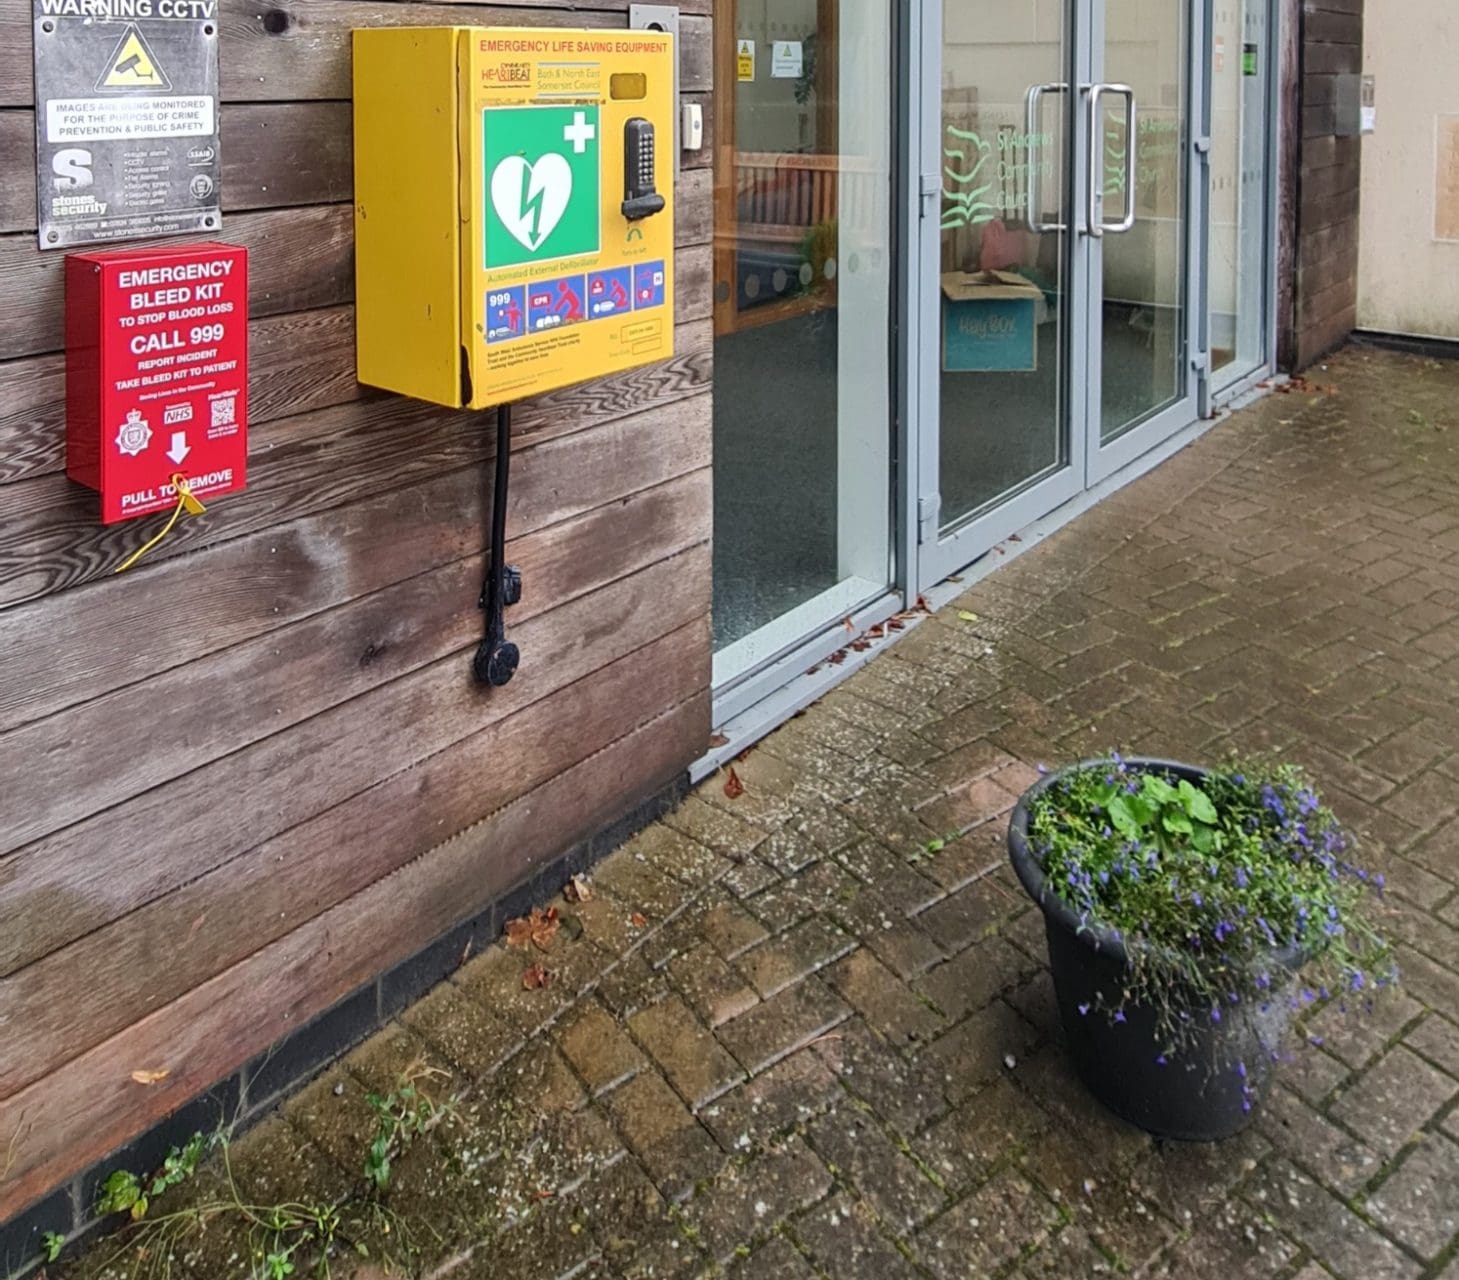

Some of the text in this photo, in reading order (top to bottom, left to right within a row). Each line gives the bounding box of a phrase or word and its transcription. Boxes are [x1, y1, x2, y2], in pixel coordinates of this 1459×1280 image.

[158, 0, 215, 18] CCTV
[480, 39, 667, 53] EMERGENCY LIFE SAVING EQUIPMENT
[537, 69, 555, 79] Bath
[562, 68, 584, 78] North
[537, 80, 572, 90] Somerset
[56, 103, 95, 113] IMAGES
[152, 100, 206, 110] MONITORED
[64, 111, 200, 124] FOR THE PURPOSE OF CRIME
[59, 122, 204, 136] PREVENTION & PUBLIC SAFETY
[52, 195, 95, 207] stones
[52, 202, 108, 216] security
[118, 260, 234, 288] EMERGENCY
[488, 269, 528, 283] Automated
[529, 263, 559, 275] External
[130, 282, 224, 310] BLEED KIT
[490, 292, 511, 307] 999
[534, 296, 548, 305] CPR
[119, 302, 234, 328] TO STOP BLOOD LOSS
[130, 323, 224, 355] CALL 999
[138, 348, 218, 370] REPORT INCIDENT
[115, 360, 237, 390] TAKE BLEED KIT TO PATIENT
[166, 407, 190, 422] NHS
[121, 488, 156, 508] PULL
[158, 484, 177, 497] TO
